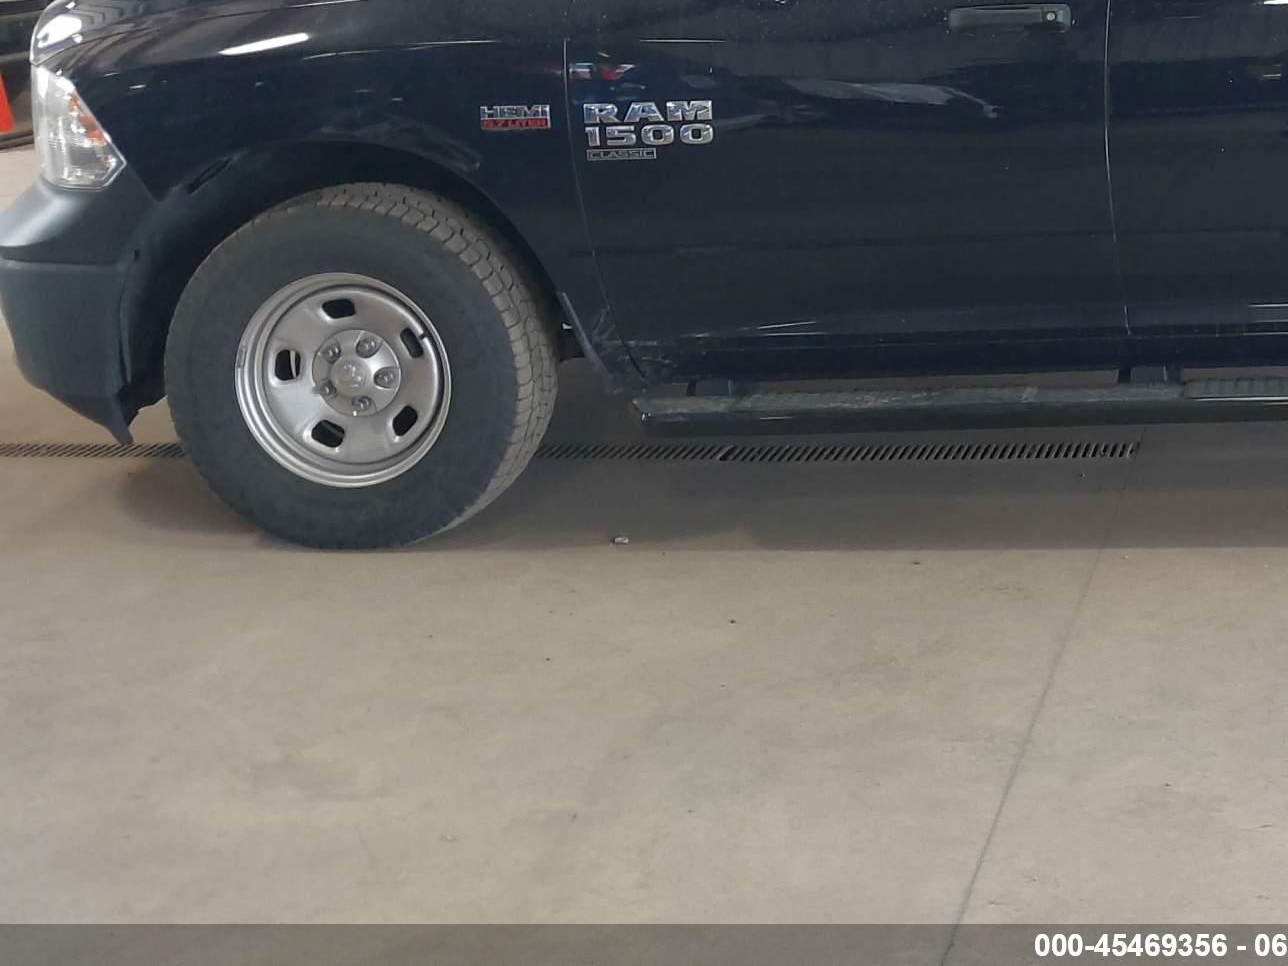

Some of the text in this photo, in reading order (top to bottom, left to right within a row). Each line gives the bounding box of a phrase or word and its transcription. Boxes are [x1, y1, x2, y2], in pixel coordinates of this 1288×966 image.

[480, 104, 550, 119] HEMI
[583, 100, 713, 123] RAM
[584, 123, 714, 146] 1500
[589, 149, 655, 159] CLASSIC
